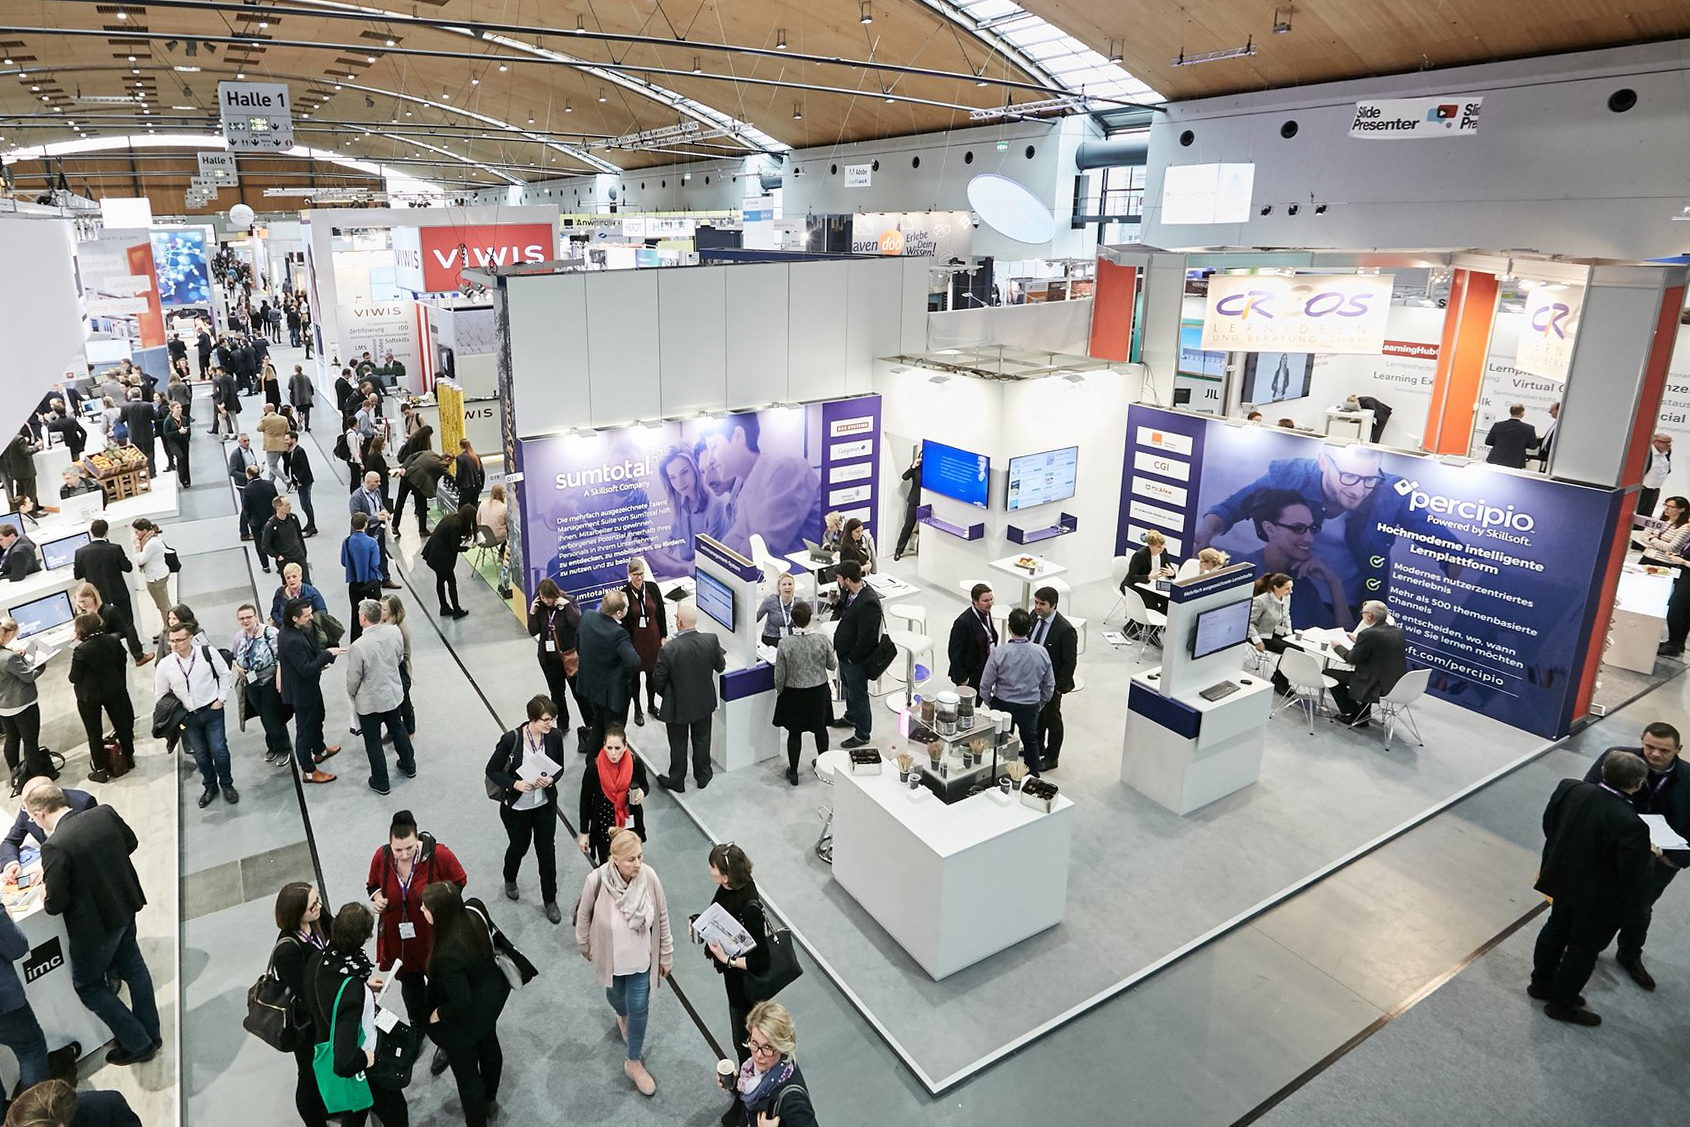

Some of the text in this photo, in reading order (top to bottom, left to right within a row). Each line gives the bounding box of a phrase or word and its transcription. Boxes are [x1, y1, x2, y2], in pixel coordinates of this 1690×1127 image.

[226, 91, 285, 107] Halle 1
[1357, 106, 1381, 118] Slide
[1352, 118, 1420, 131] Presenter
[202, 157, 226, 165] Halle
[906, 231, 928, 243] Erlebe
[917, 240, 933, 248] Dein
[433, 244, 545, 269] VIWIS
[906, 242, 937, 257] Wissen!
[394, 249, 419, 269] VIWIS
[354, 307, 402, 317] VIWIS
[1212, 334, 1239, 342] UND
[1373, 371, 1434, 386] Learning Ex
[1512, 378, 1555, 392] Virtual
[1204, 388, 1220, 400] JIL
[464, 408, 493, 420] WIS
[1153, 460, 1170, 472] CGI
[584, 480, 651, 497] A Skillsoft Company
[568, 512, 600, 522] mehrfach
[600, 503, 648, 517] ausgezeichnete
[649, 499, 668, 508] Talent
[1408, 490, 1535, 532] percipio
[557, 520, 600, 533] Management
[600, 516, 617, 525] Suite
[629, 509, 658, 521] SumTotal
[658, 506, 671, 515] hilft
[1426, 514, 1470, 532] Powered
[1471, 525, 1484, 537] by
[1644, 519, 1663, 529] E10
[557, 524, 671, 551] verborgenes Potenzial innerhalb Ihres
[578, 527, 613, 540] Mitarbeiter
[614, 524, 622, 532] zu
[558, 548, 589, 559] Personals
[597, 543, 616, 552] Ihrem
[616, 534, 659, 549] Unternehmen
[1376, 521, 1546, 573] Hochmoderne intelligente
[559, 561, 568, 569] zu
[605, 552, 613, 560] zu
[1409, 543, 1500, 575] Lernplattform
[568, 566, 592, 575] nutzen
[592, 562, 606, 570] und
[605, 560, 615, 568] zu
[1392, 572, 1452, 595] Lernerlebnis
[1393, 562, 1534, 608] Modernes nutzerzentriertes
[576, 584, 627, 600] mtotalsyste
[1388, 595, 1433, 615] Channels
[1389, 585, 1539, 637] Mehr als 500 themenbasierte
[1391, 621, 1525, 670] nd wie Sie lernen möchten
[1486, 641, 1517, 657] wann
[1405, 646, 1505, 687] ft.com/percipio
[26, 955, 62, 981] imc
